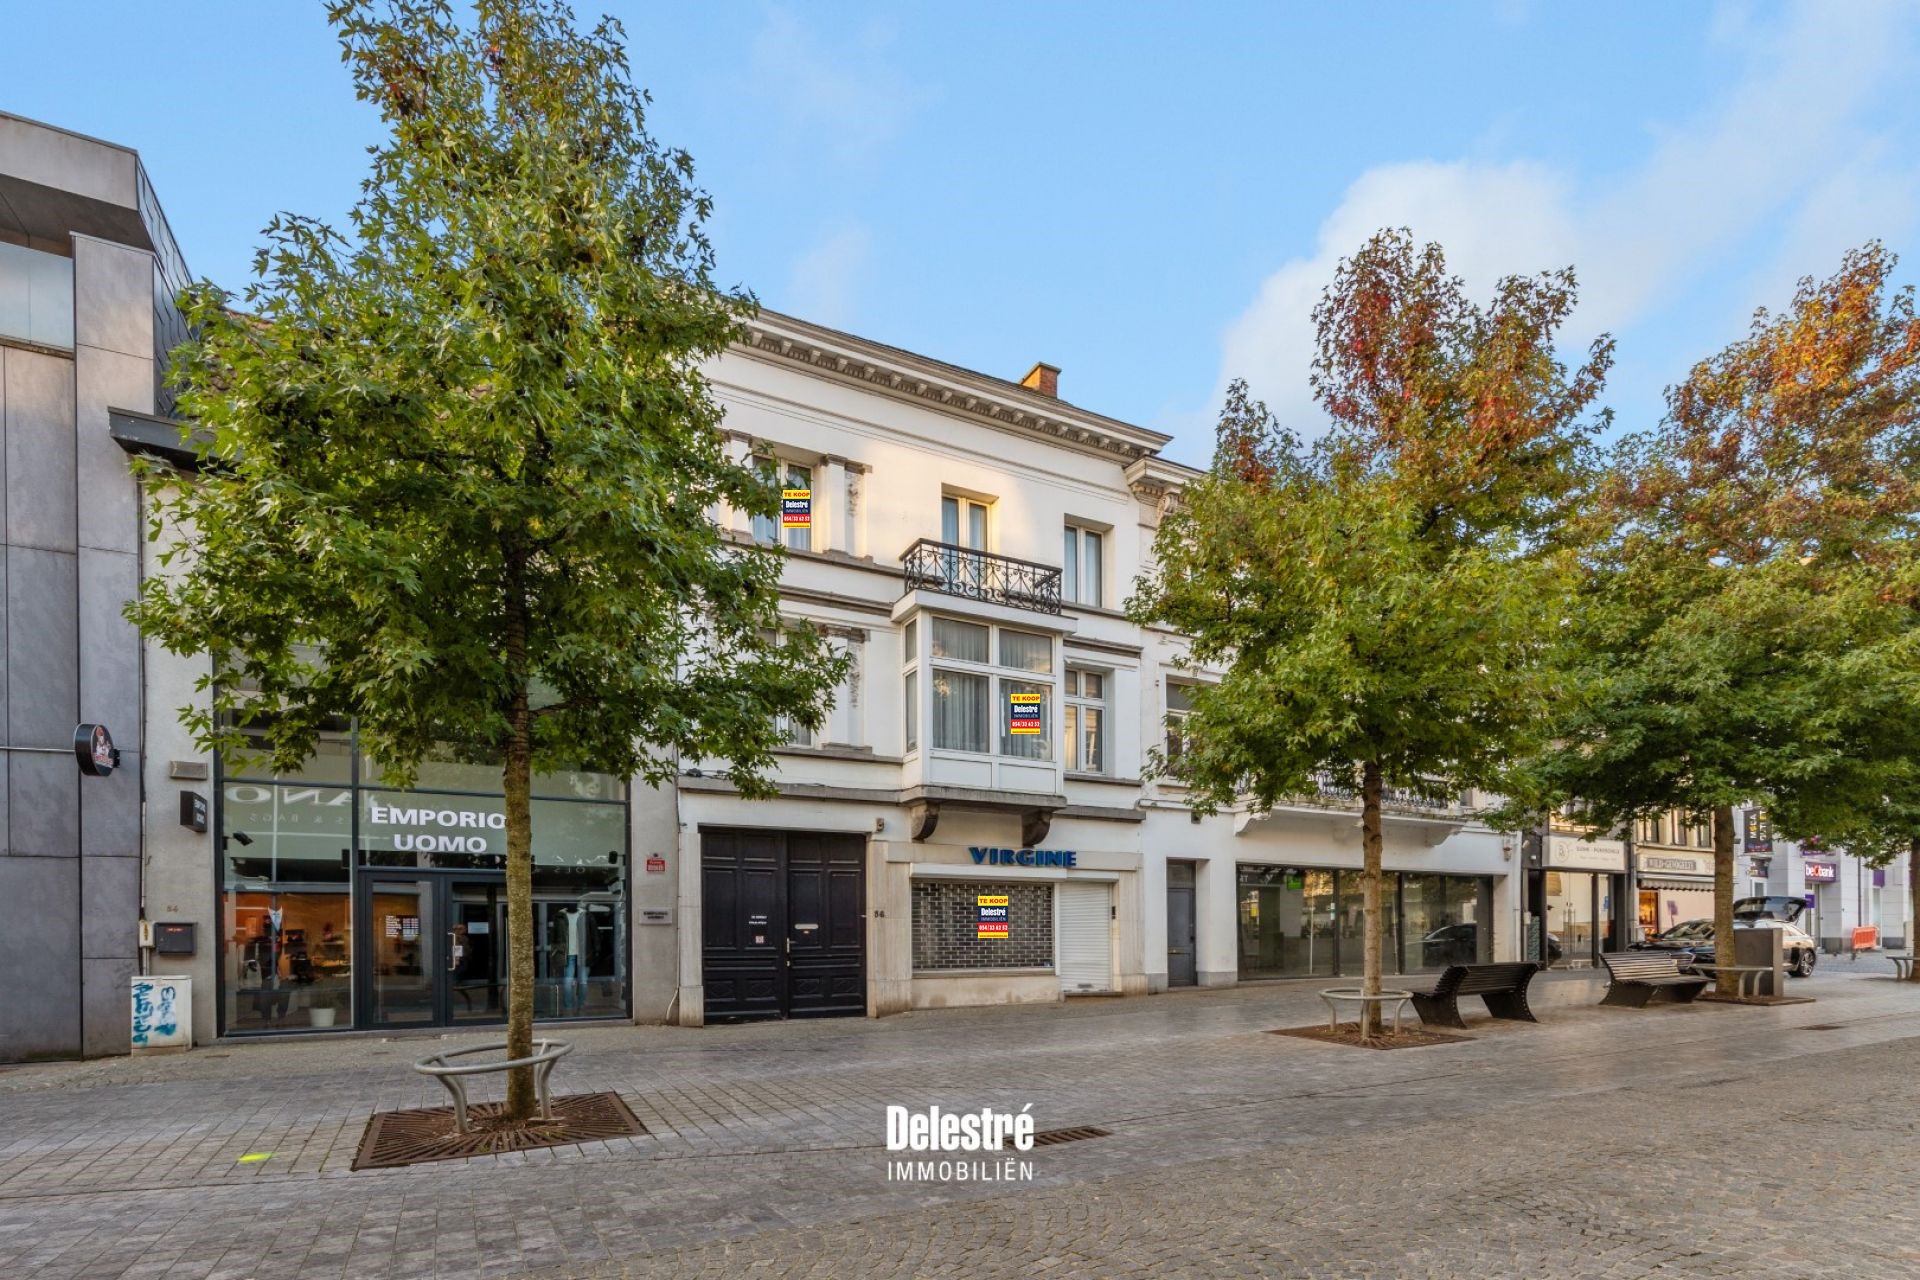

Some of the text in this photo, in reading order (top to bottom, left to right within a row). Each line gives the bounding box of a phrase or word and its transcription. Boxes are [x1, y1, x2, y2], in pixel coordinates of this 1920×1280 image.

[1014, 705, 1038, 713] Delestré
[371, 806, 507, 829] EMPORIO
[394, 834, 487, 853] UOMO
[968, 847, 1077, 867] VIRGINE
[981, 907, 1006, 916] Delestré
